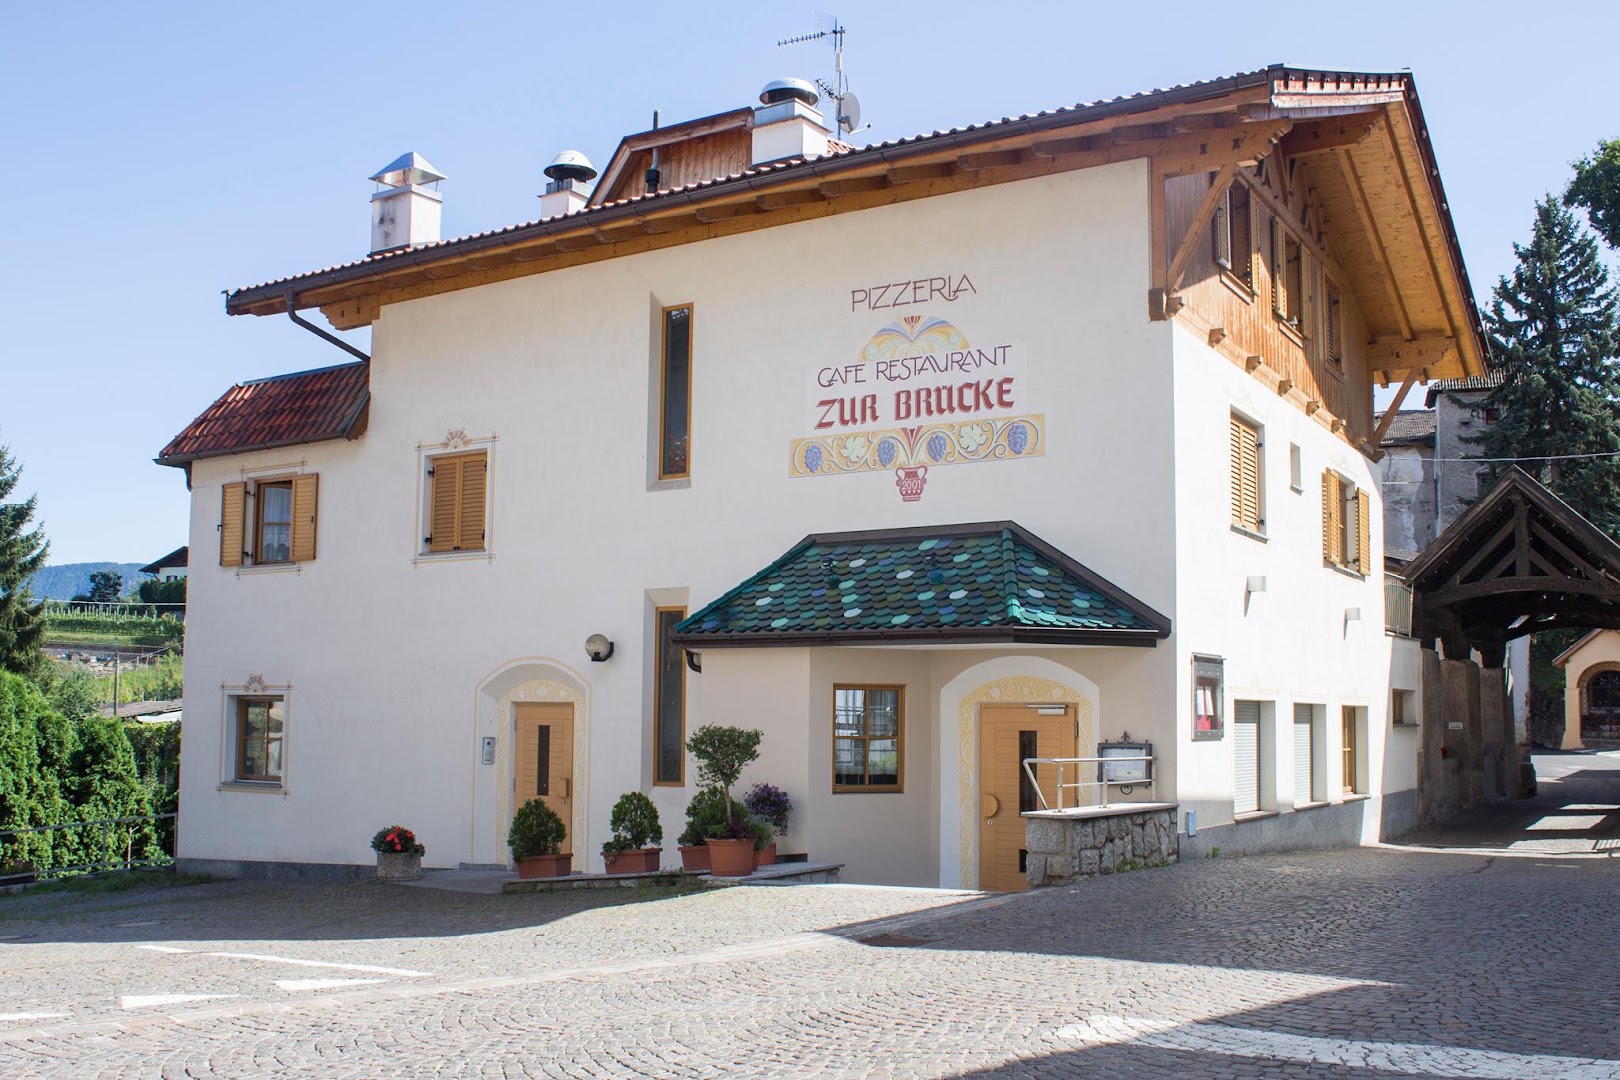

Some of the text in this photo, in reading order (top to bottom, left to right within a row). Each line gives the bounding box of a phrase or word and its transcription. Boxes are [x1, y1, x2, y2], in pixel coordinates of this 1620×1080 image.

[851, 274, 977, 312] PIZZERIA
[817, 345, 1012, 388] CAFE RESTAURANT
[814, 376, 1015, 430] ZUR BRÜCKE
[902, 480, 922, 489] 2001
